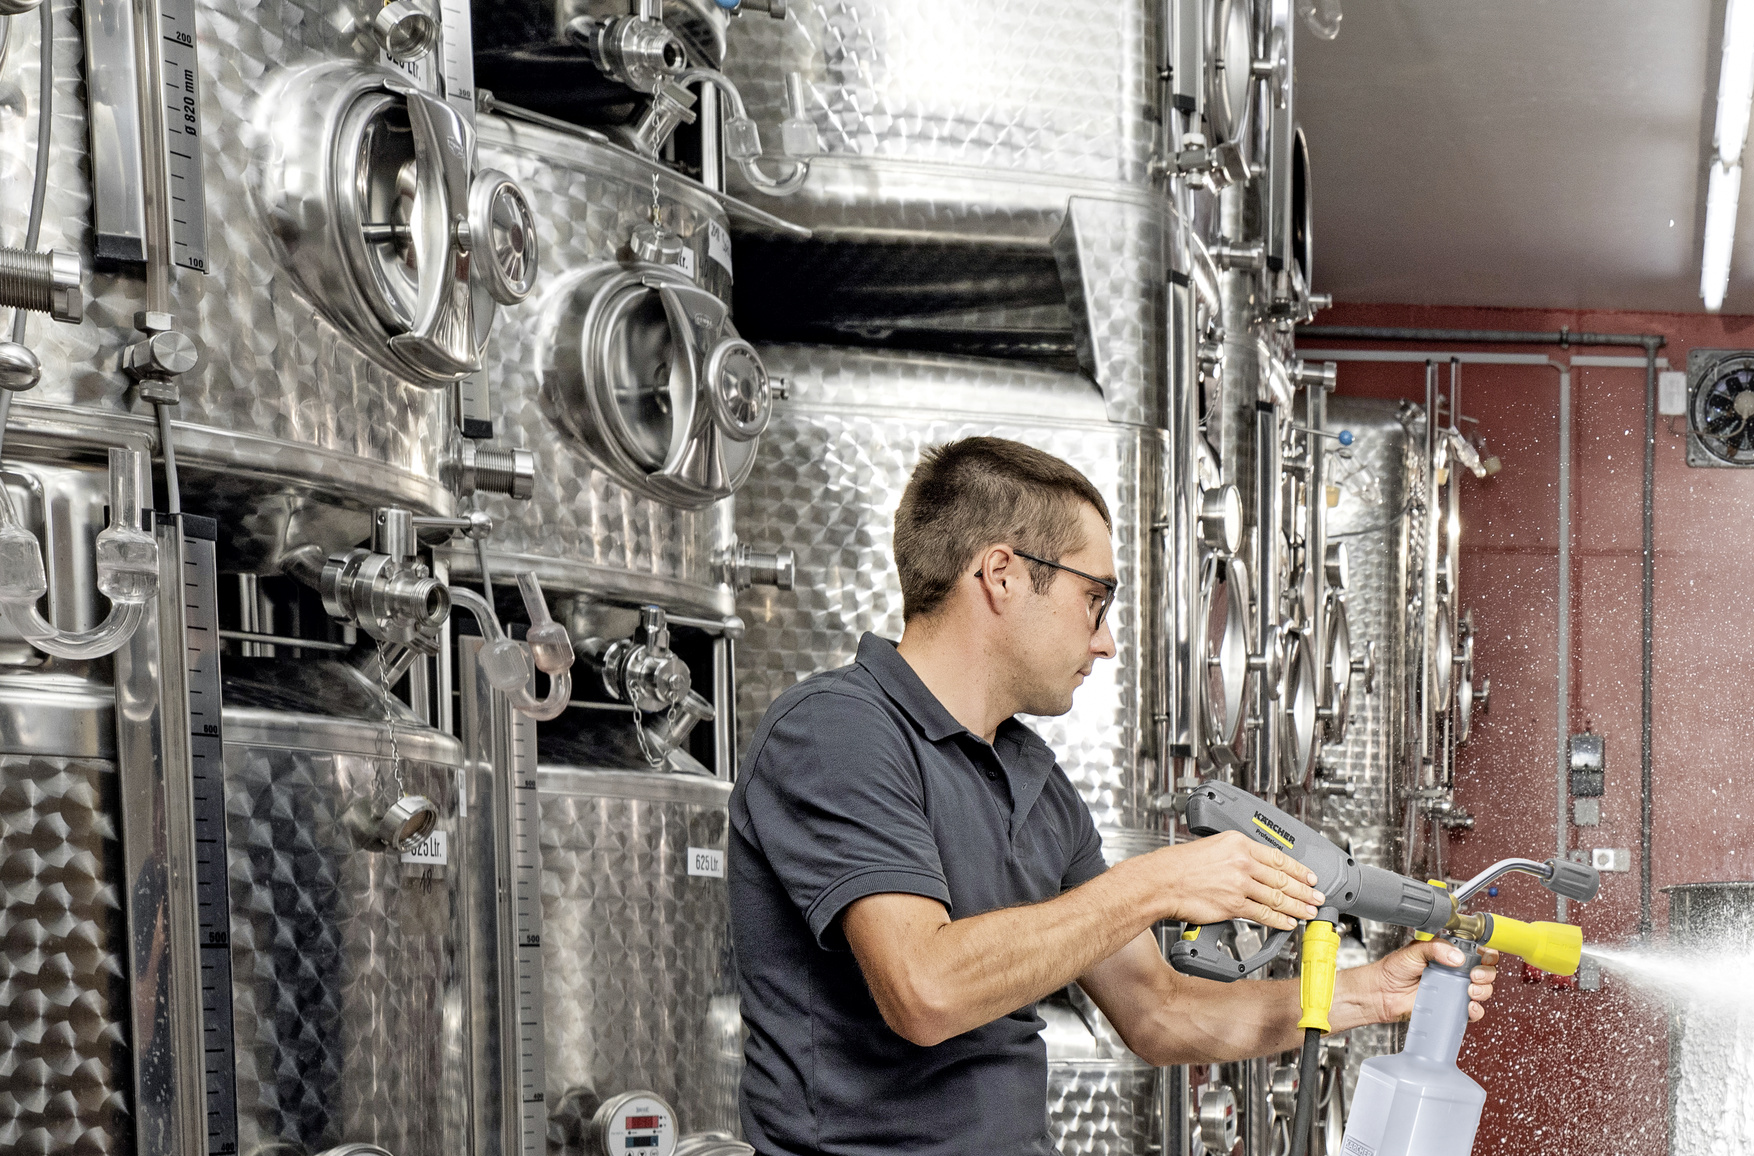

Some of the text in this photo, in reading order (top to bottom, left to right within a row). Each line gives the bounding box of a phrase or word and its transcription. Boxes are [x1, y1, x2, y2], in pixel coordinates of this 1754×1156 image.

[176, 31, 192, 44] 200
[185, 69, 194, 93] mm
[458, 88, 471, 98] 300
[184, 97, 196, 123] 820
[188, 257, 204, 268] 100
[203, 724, 218, 734] 600
[1253, 810, 1296, 845] KÄRCHER
[1255, 828, 1284, 851] Professional
[430, 837, 442, 858] Ltr.
[695, 854, 720, 872] 625 Ltr.
[209, 931, 227, 942] 500
[526, 934, 540, 943] 500
[221, 1142, 235, 1152] 400
